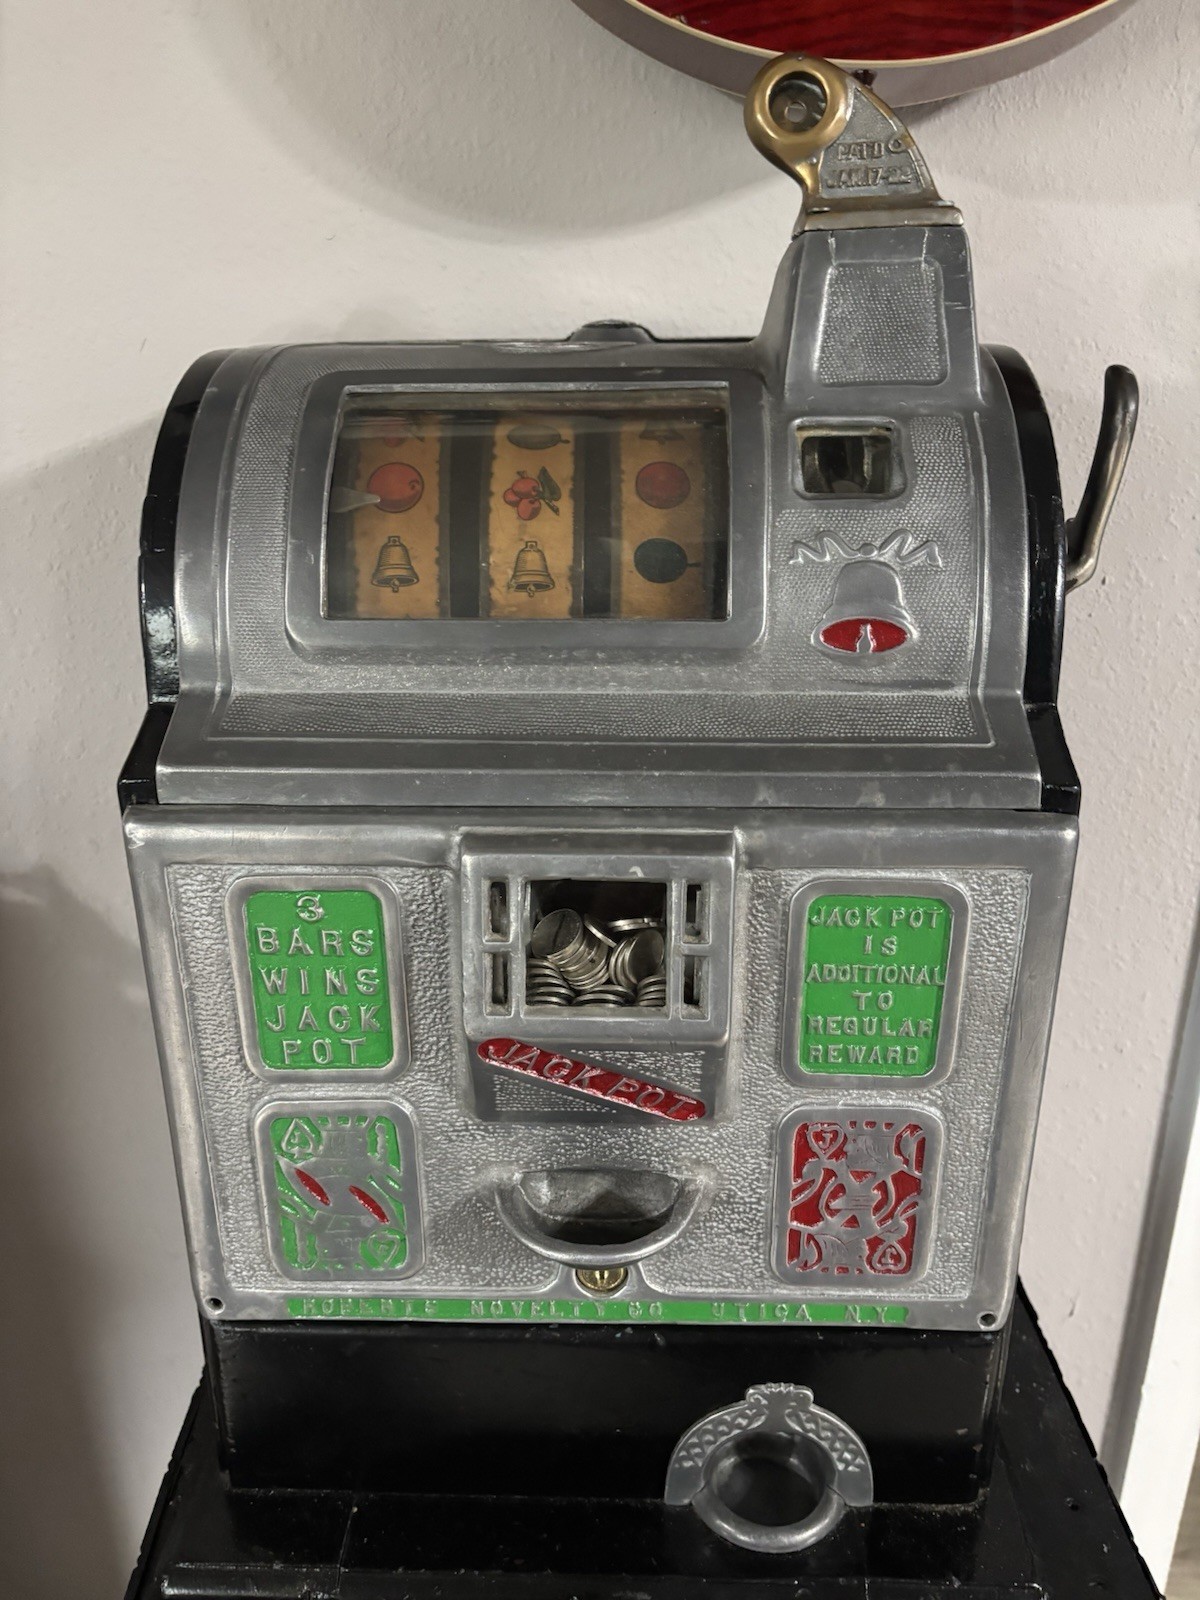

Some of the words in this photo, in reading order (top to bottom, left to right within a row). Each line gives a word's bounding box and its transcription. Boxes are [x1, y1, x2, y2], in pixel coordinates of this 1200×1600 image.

[296, 895, 325, 922] 3
[808, 905, 881, 927] JACK
[891, 906, 944, 928] POT
[256, 926, 374, 956] BARS
[863, 934, 898, 956] IS
[259, 966, 379, 996] WINS
[806, 963, 945, 986] ADDITIONAL
[852, 990, 894, 1011] TO
[266, 1004, 382, 1032] JACK
[808, 1015, 934, 1038] REGULAR
[282, 1037, 366, 1064] POT
[808, 1044, 919, 1065] REWARD
[488, 1040, 604, 1088] JACK
[606, 1076, 697, 1115] POT
